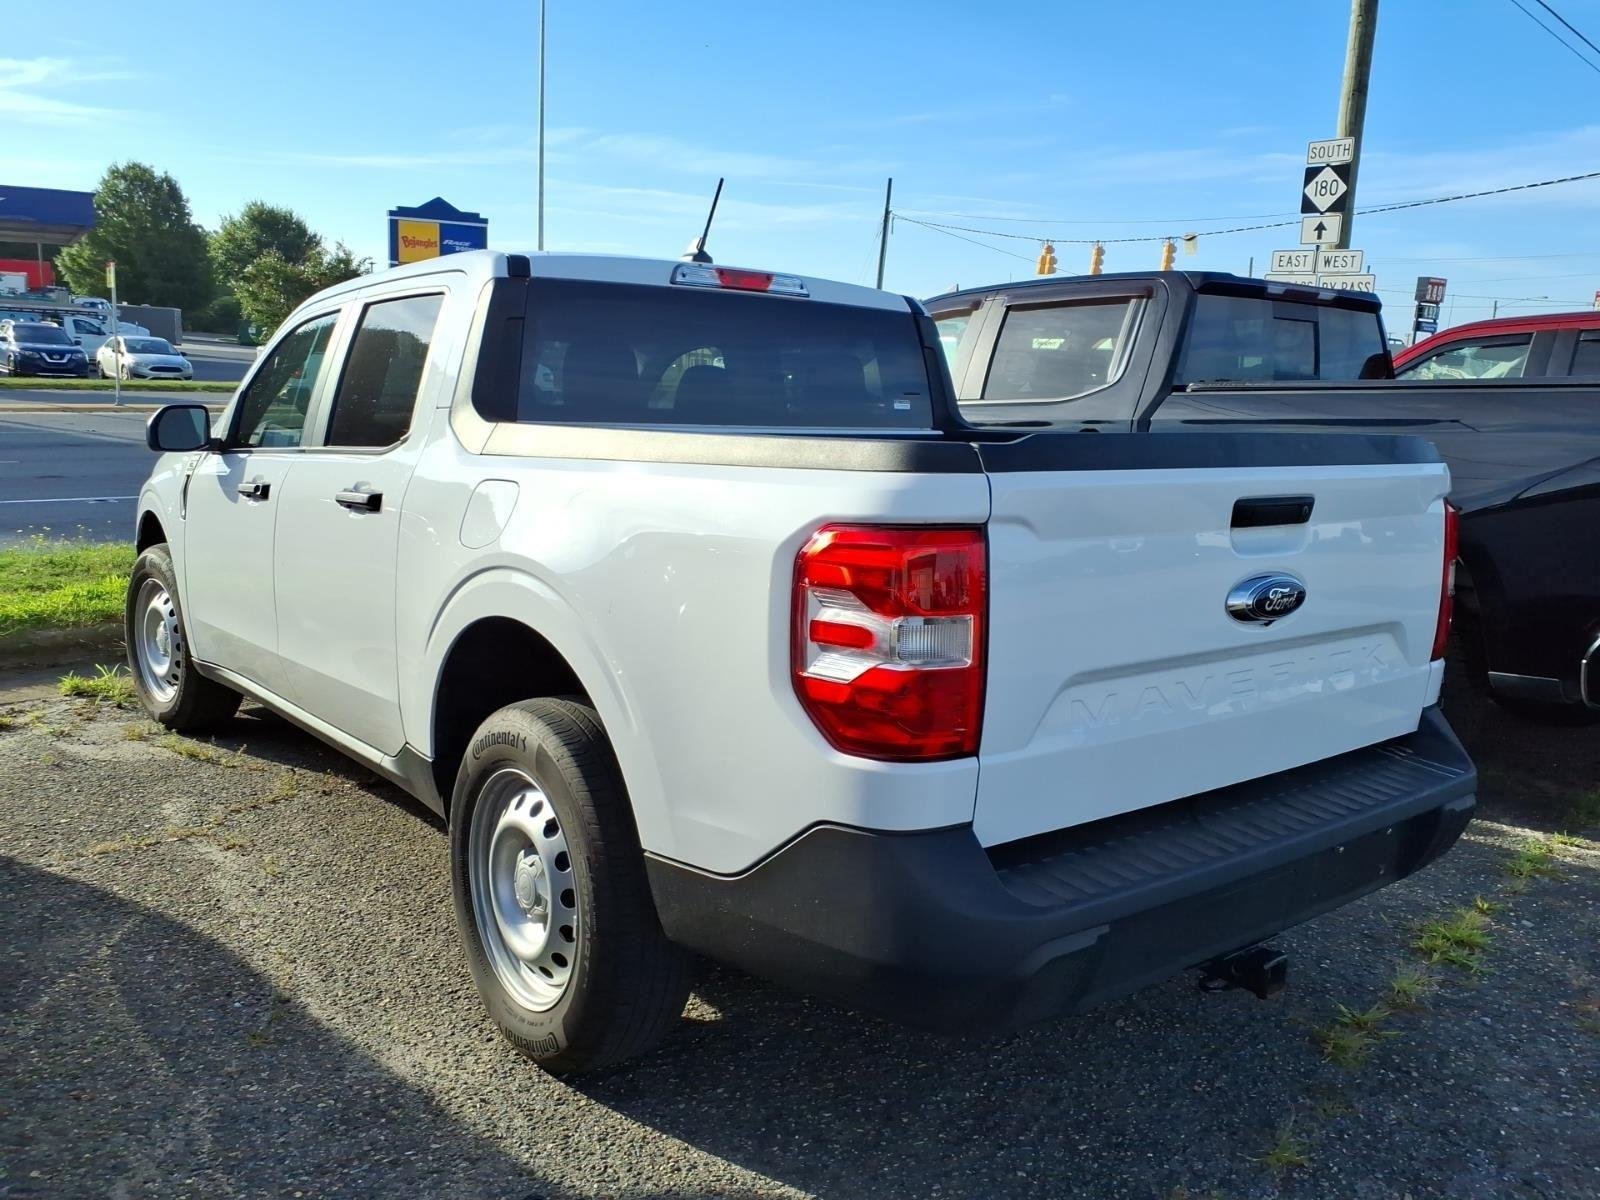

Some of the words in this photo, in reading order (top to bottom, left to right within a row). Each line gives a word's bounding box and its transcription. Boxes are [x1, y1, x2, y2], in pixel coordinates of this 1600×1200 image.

[1310, 144, 1351, 159] SOUTH
[1314, 179, 1339, 197] 180
[1278, 254, 1309, 268] EAST
[1323, 255, 1357, 269] WEST
[1265, 587, 1298, 611] Ford
[1071, 642, 1385, 728] MAVERICK
[472, 730, 521, 761] Continental
